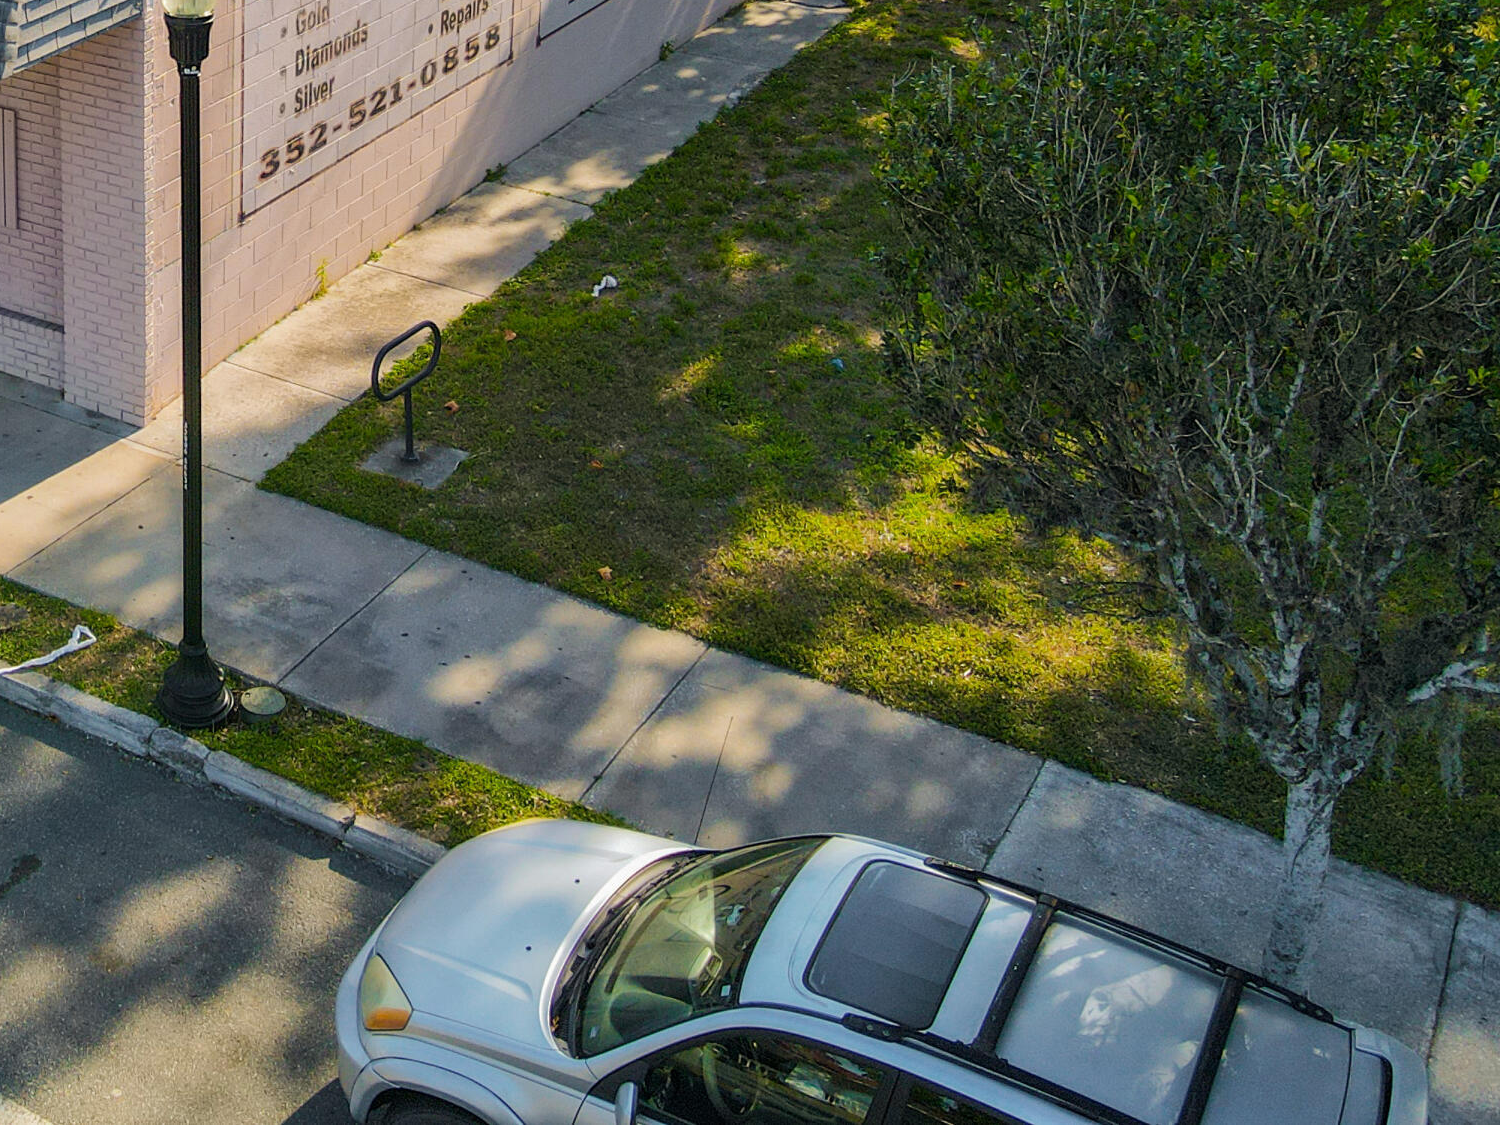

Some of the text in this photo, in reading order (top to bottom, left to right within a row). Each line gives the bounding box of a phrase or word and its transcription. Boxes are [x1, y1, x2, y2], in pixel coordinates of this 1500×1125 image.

[295, 20, 369, 78] Diamonds
[259, 23, 500, 180] 352-521-0858
[294, 76, 336, 116] Silver
